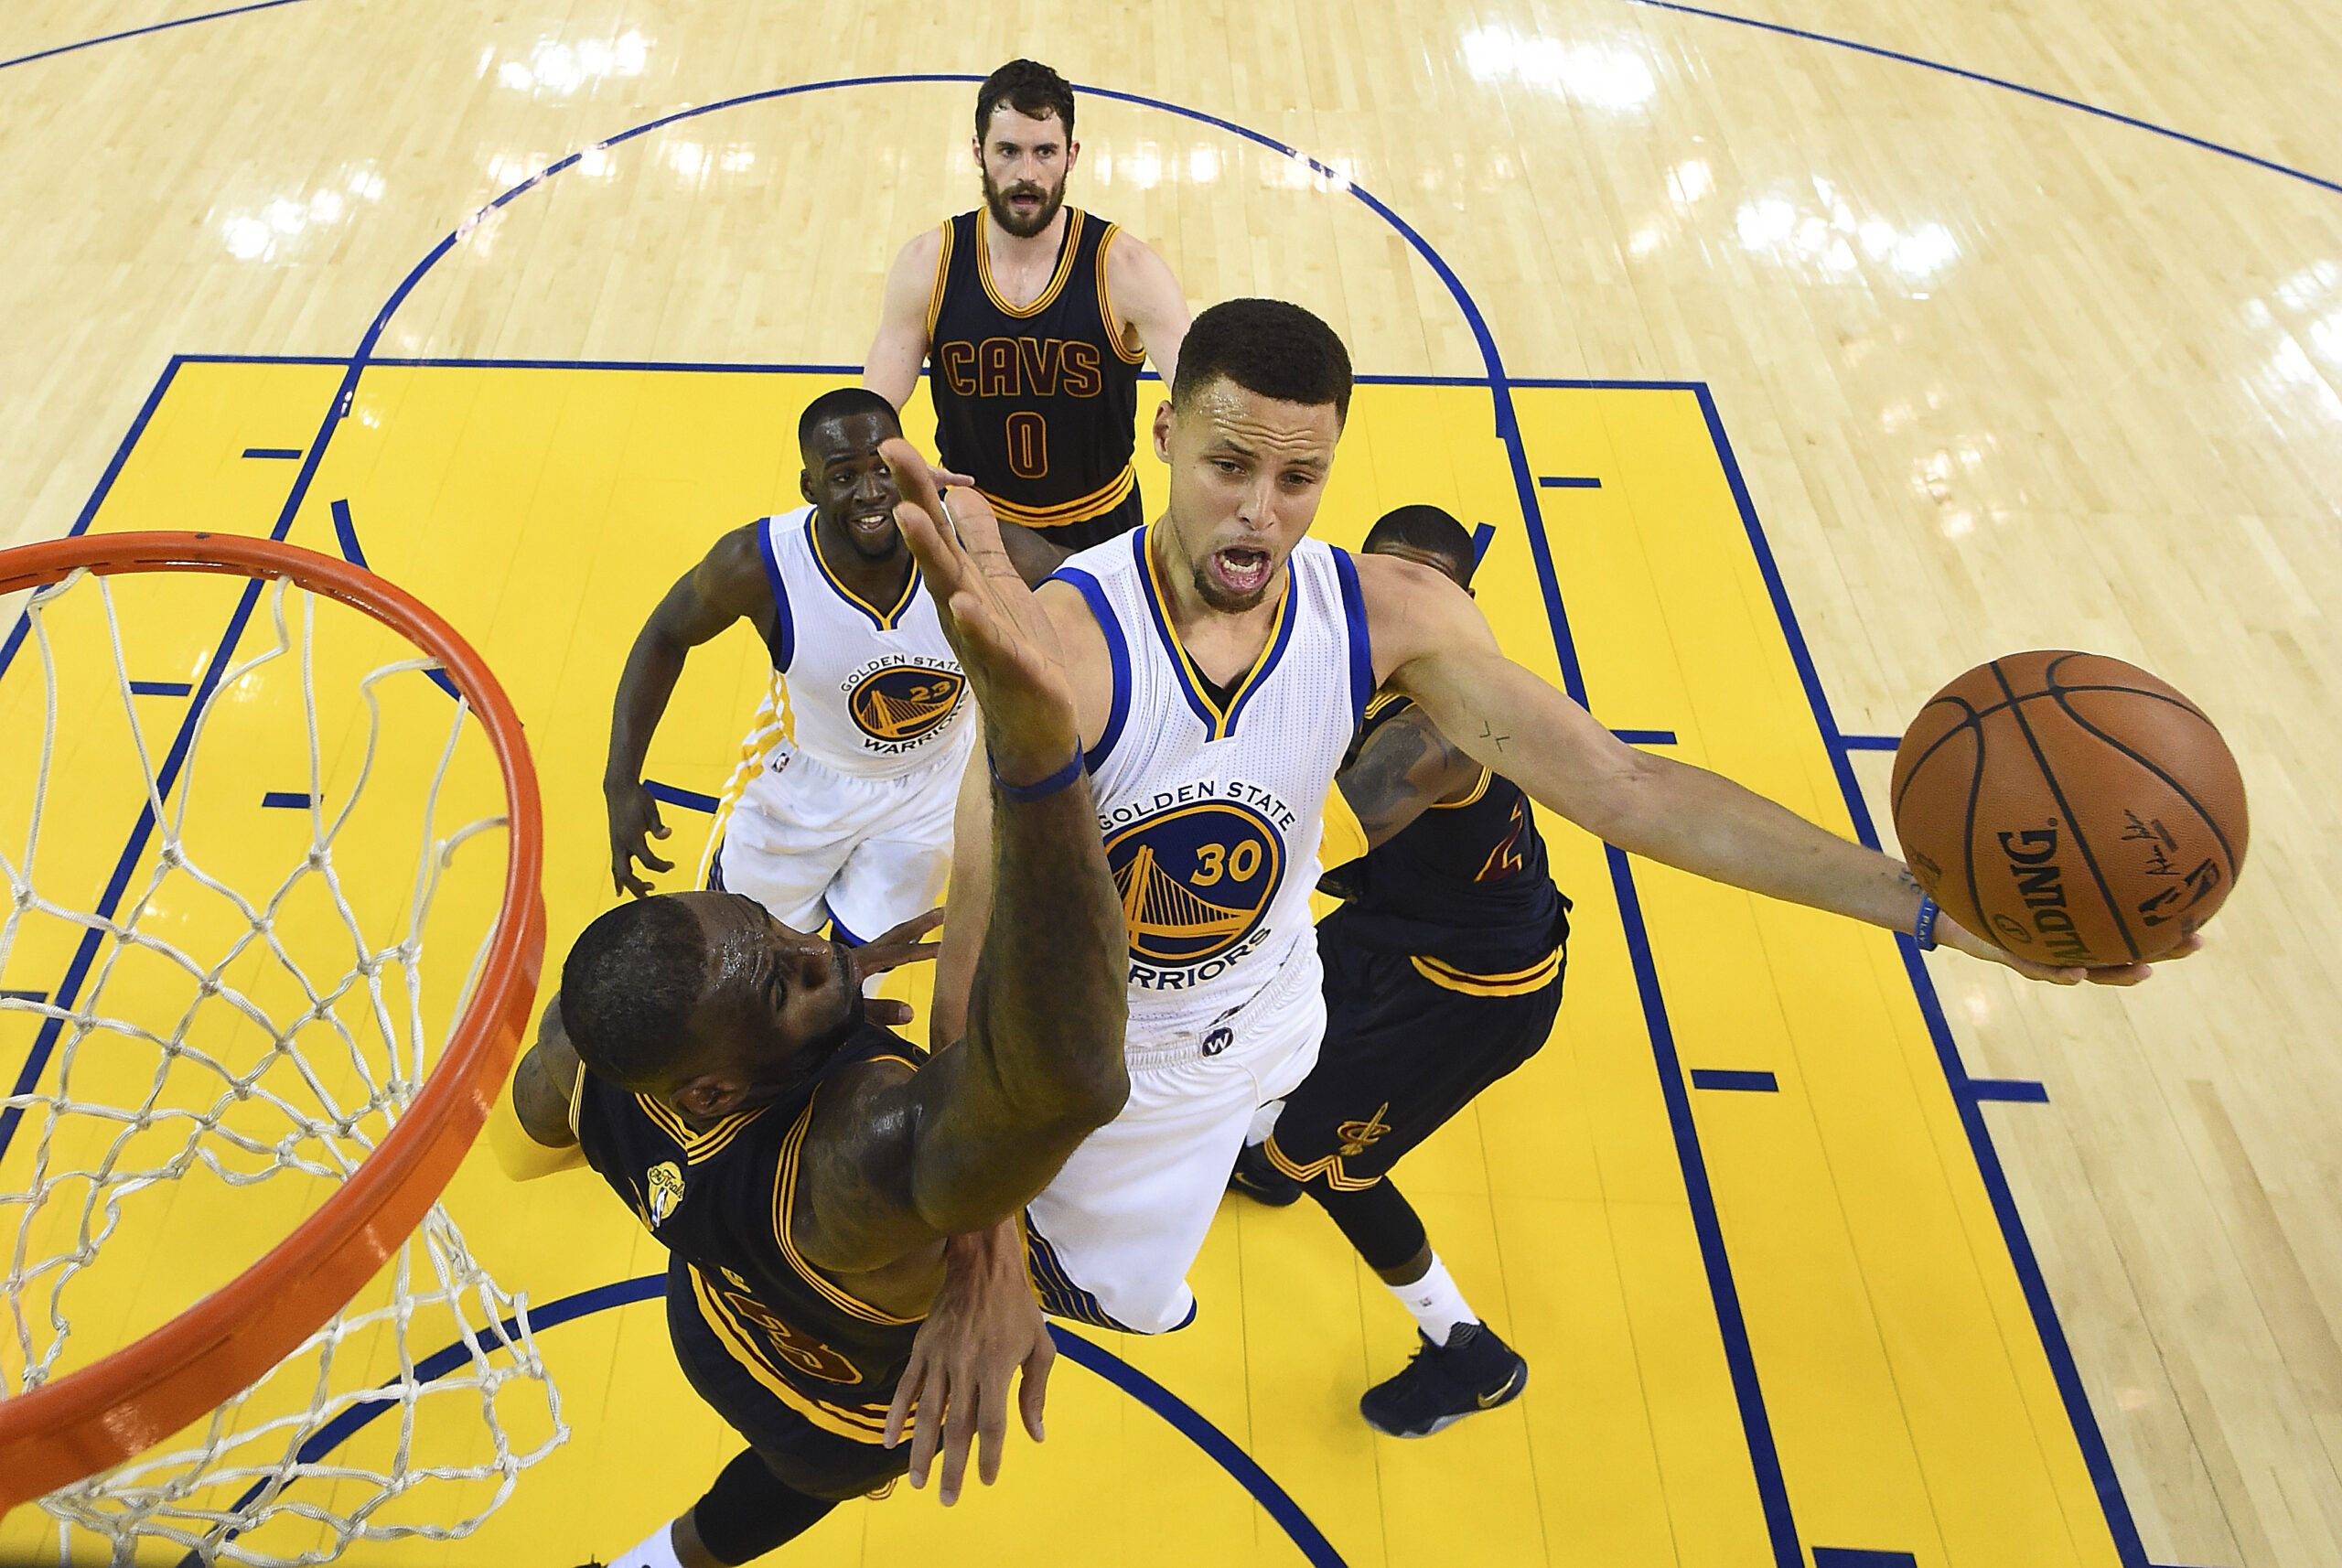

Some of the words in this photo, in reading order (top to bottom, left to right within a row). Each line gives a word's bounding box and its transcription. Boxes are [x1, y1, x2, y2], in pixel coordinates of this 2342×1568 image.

[940, 337, 1102, 398] CAVS
[1006, 411, 1048, 478] 0
[841, 654, 906, 693] GOLDEN
[913, 657, 962, 672] STATE
[909, 681, 951, 703] 23
[1098, 780, 1215, 831] GOLDEN
[1227, 781, 1296, 832] STATE
[1190, 839, 1262, 886] 30
[1997, 829, 2095, 961] ALDING
[1128, 928, 1273, 991] RRIORS
[1206, 1031, 1231, 1054] W
